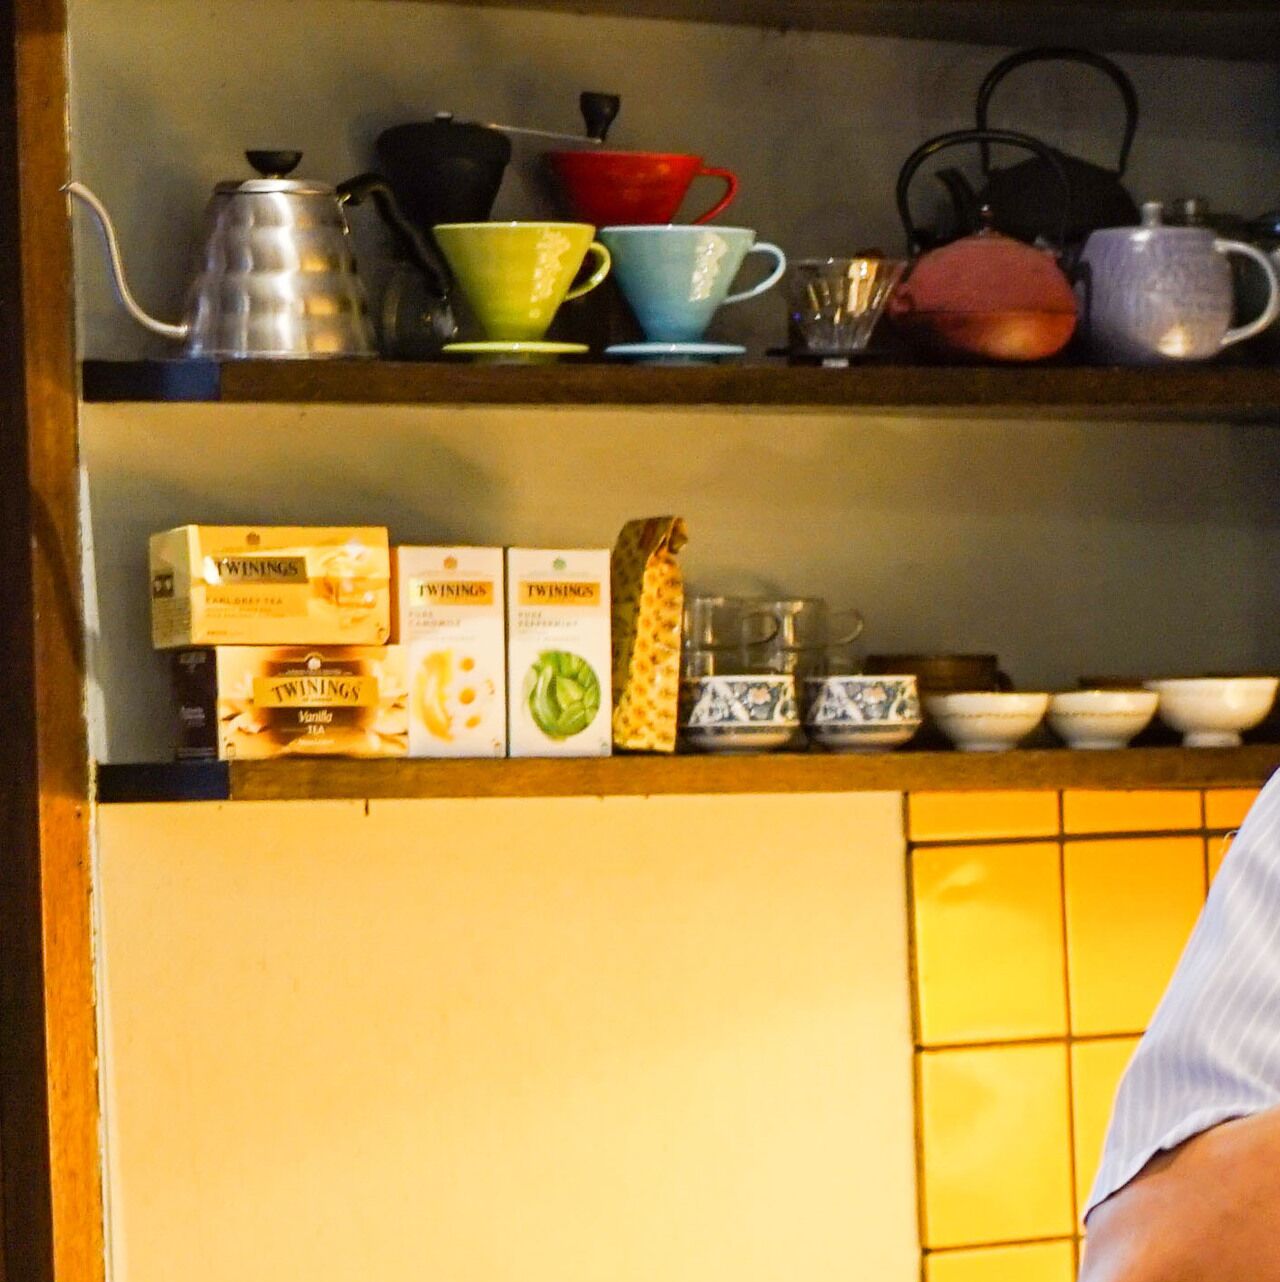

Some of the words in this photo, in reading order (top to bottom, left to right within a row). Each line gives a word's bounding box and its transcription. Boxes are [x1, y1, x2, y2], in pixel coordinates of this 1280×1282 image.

[216, 561, 298, 576] TWININGS
[417, 583, 487, 598] TWININGS
[527, 584, 594, 599] TWININGS
[271, 678, 361, 703] TWININGS
[298, 709, 334, 724] Vanilla
[307, 724, 326, 736] TEA
